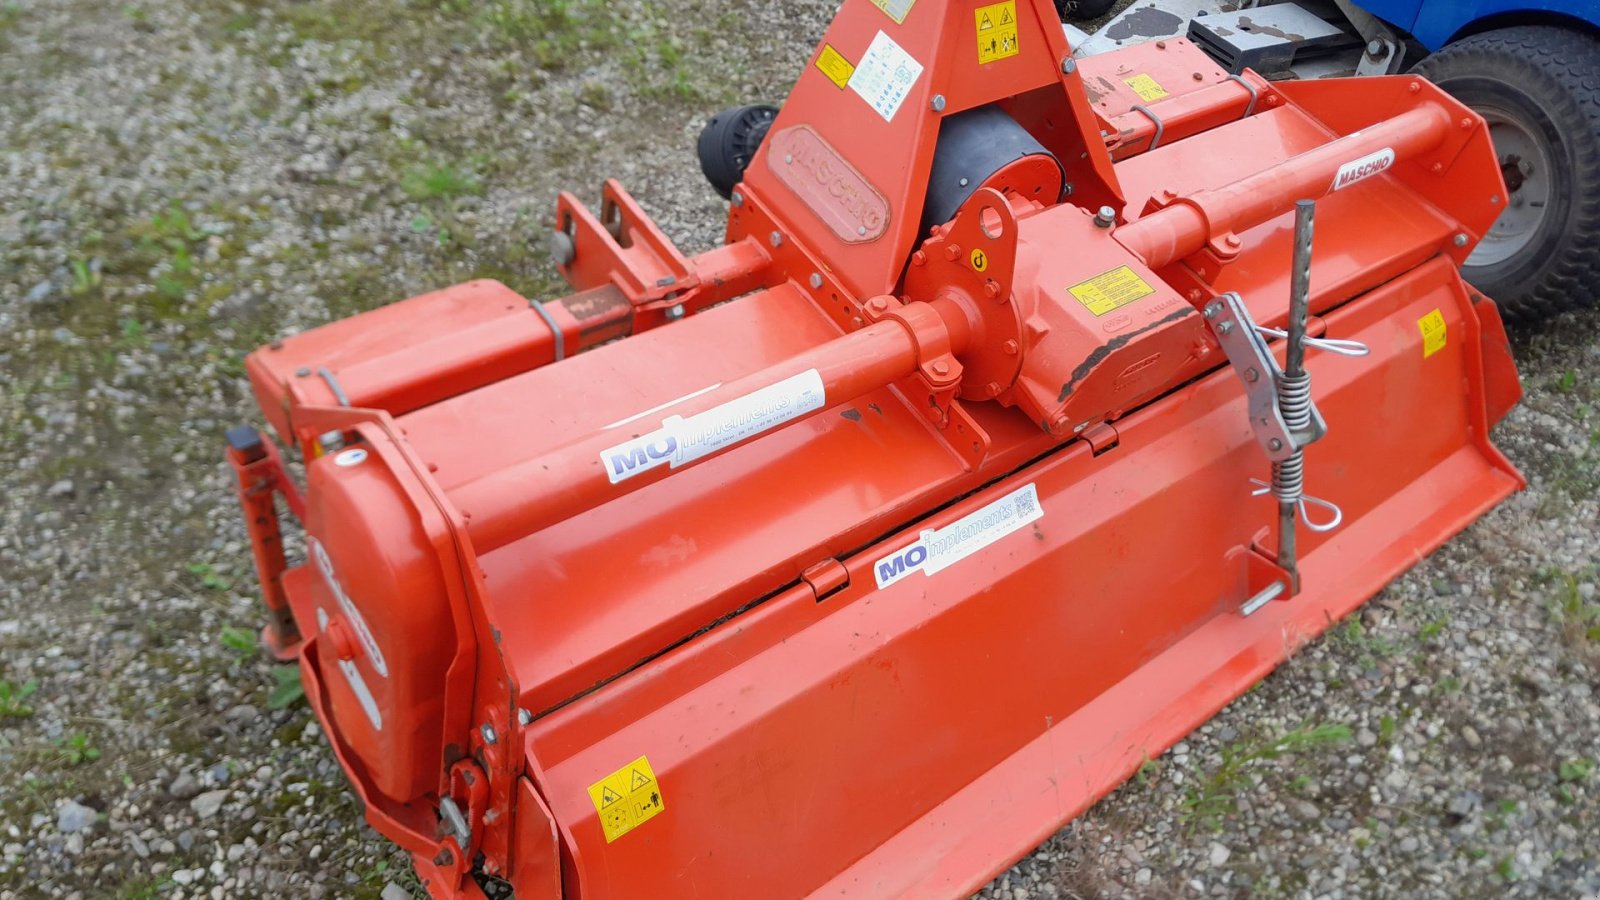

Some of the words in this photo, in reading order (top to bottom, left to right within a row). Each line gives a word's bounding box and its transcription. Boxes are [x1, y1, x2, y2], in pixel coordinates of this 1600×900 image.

[1338, 156, 1390, 187] MASCHIO
[878, 545, 928, 582] MO
[925, 503, 1013, 561] implements
